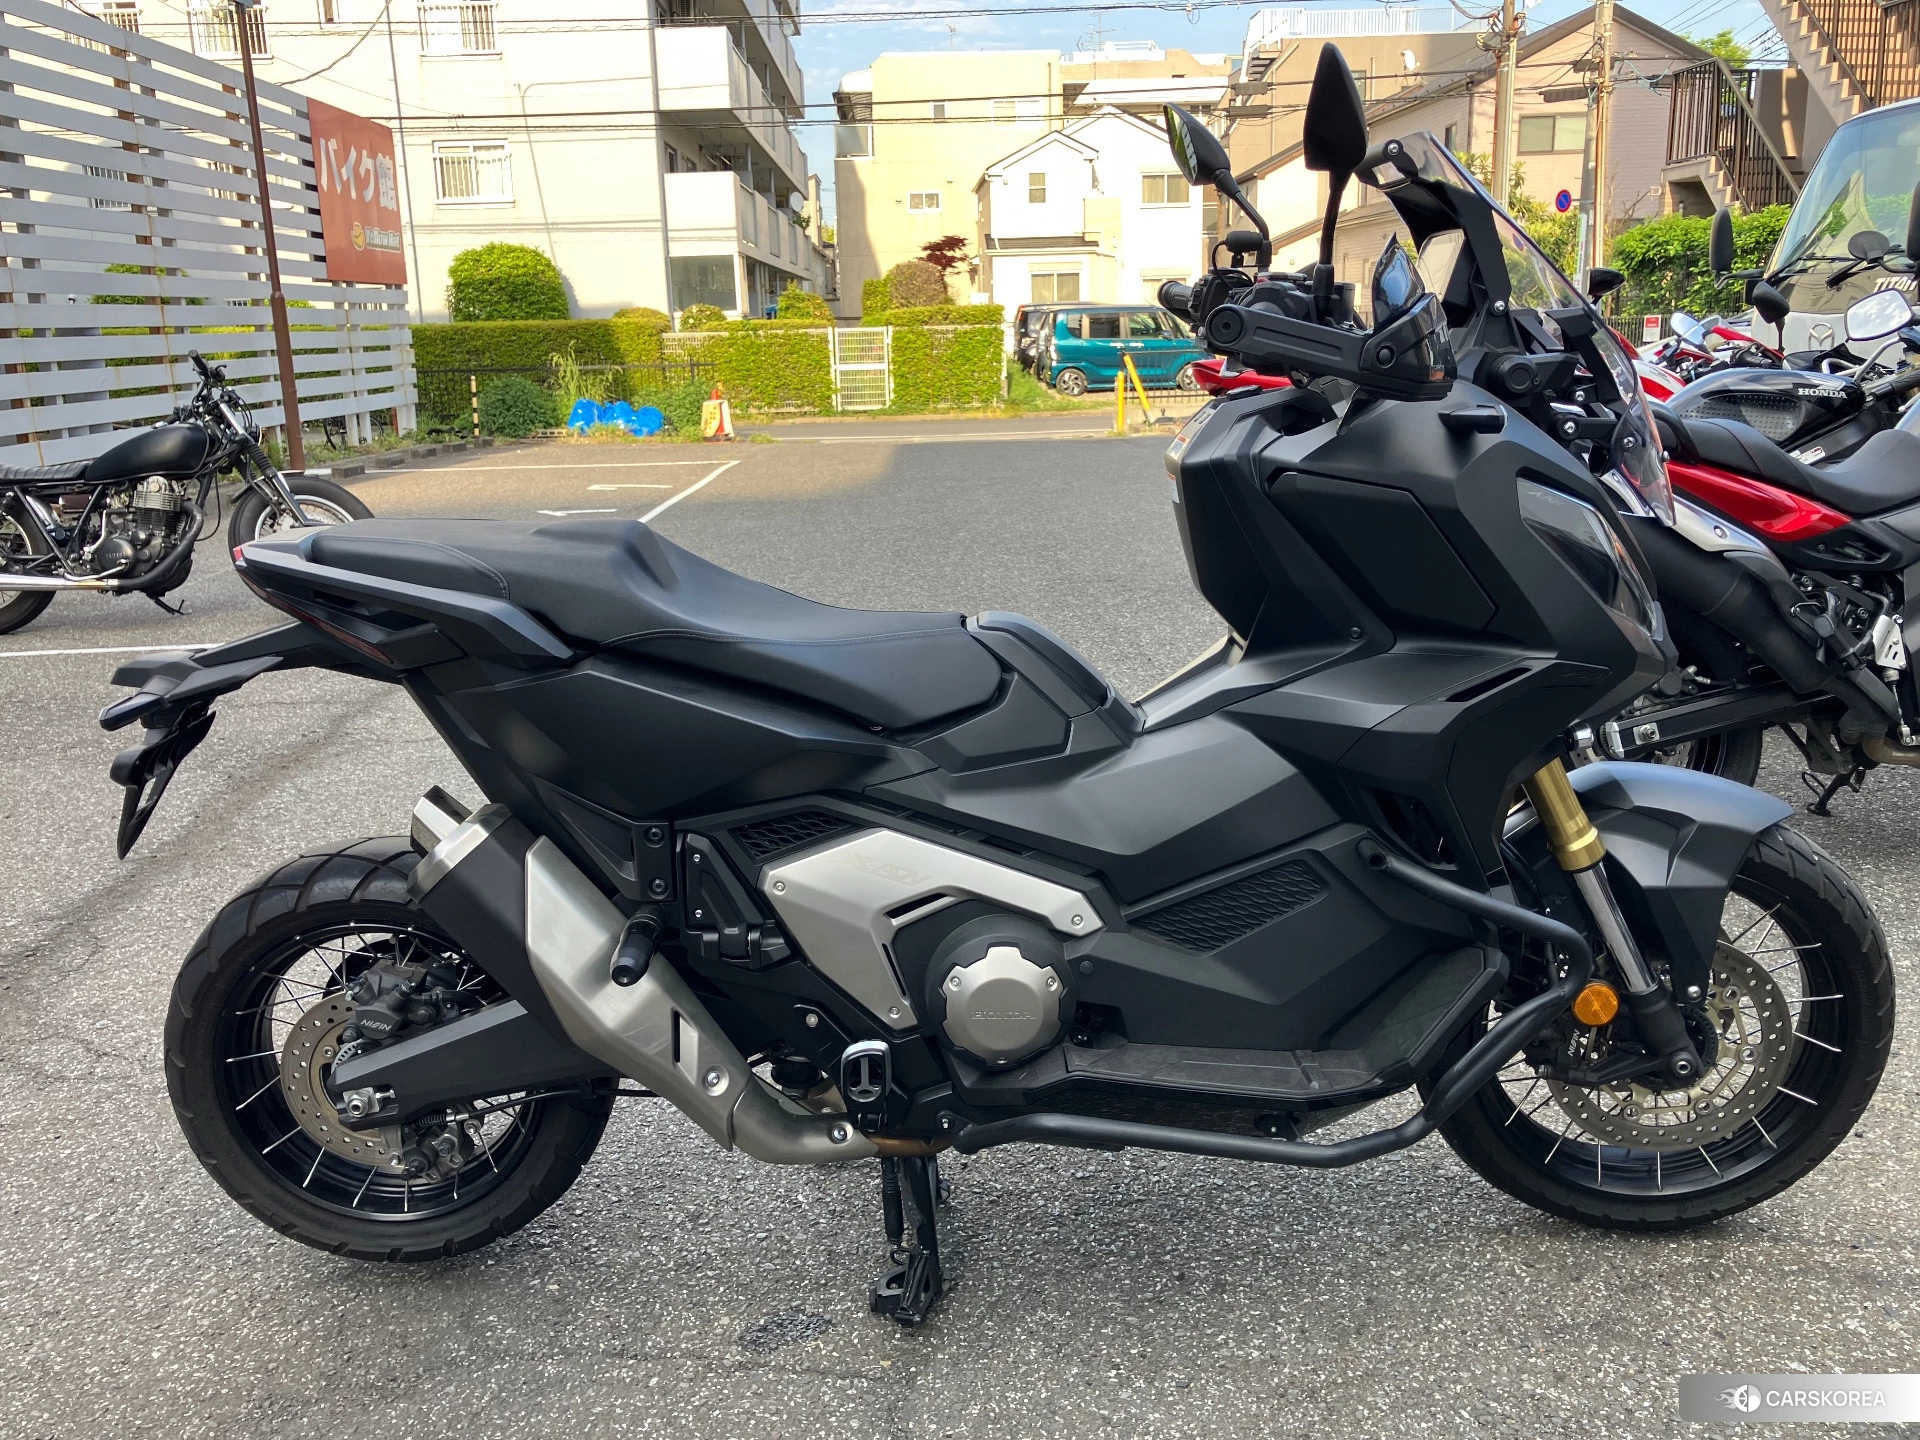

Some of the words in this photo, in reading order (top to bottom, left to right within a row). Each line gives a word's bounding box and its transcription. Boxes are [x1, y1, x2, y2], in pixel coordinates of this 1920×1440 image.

[319, 137, 397, 211] バイク館
[1873, 276, 1918, 293] TITAN
[1797, 387, 1848, 399] HONDA
[972, 1010, 1036, 1020] HONDA
